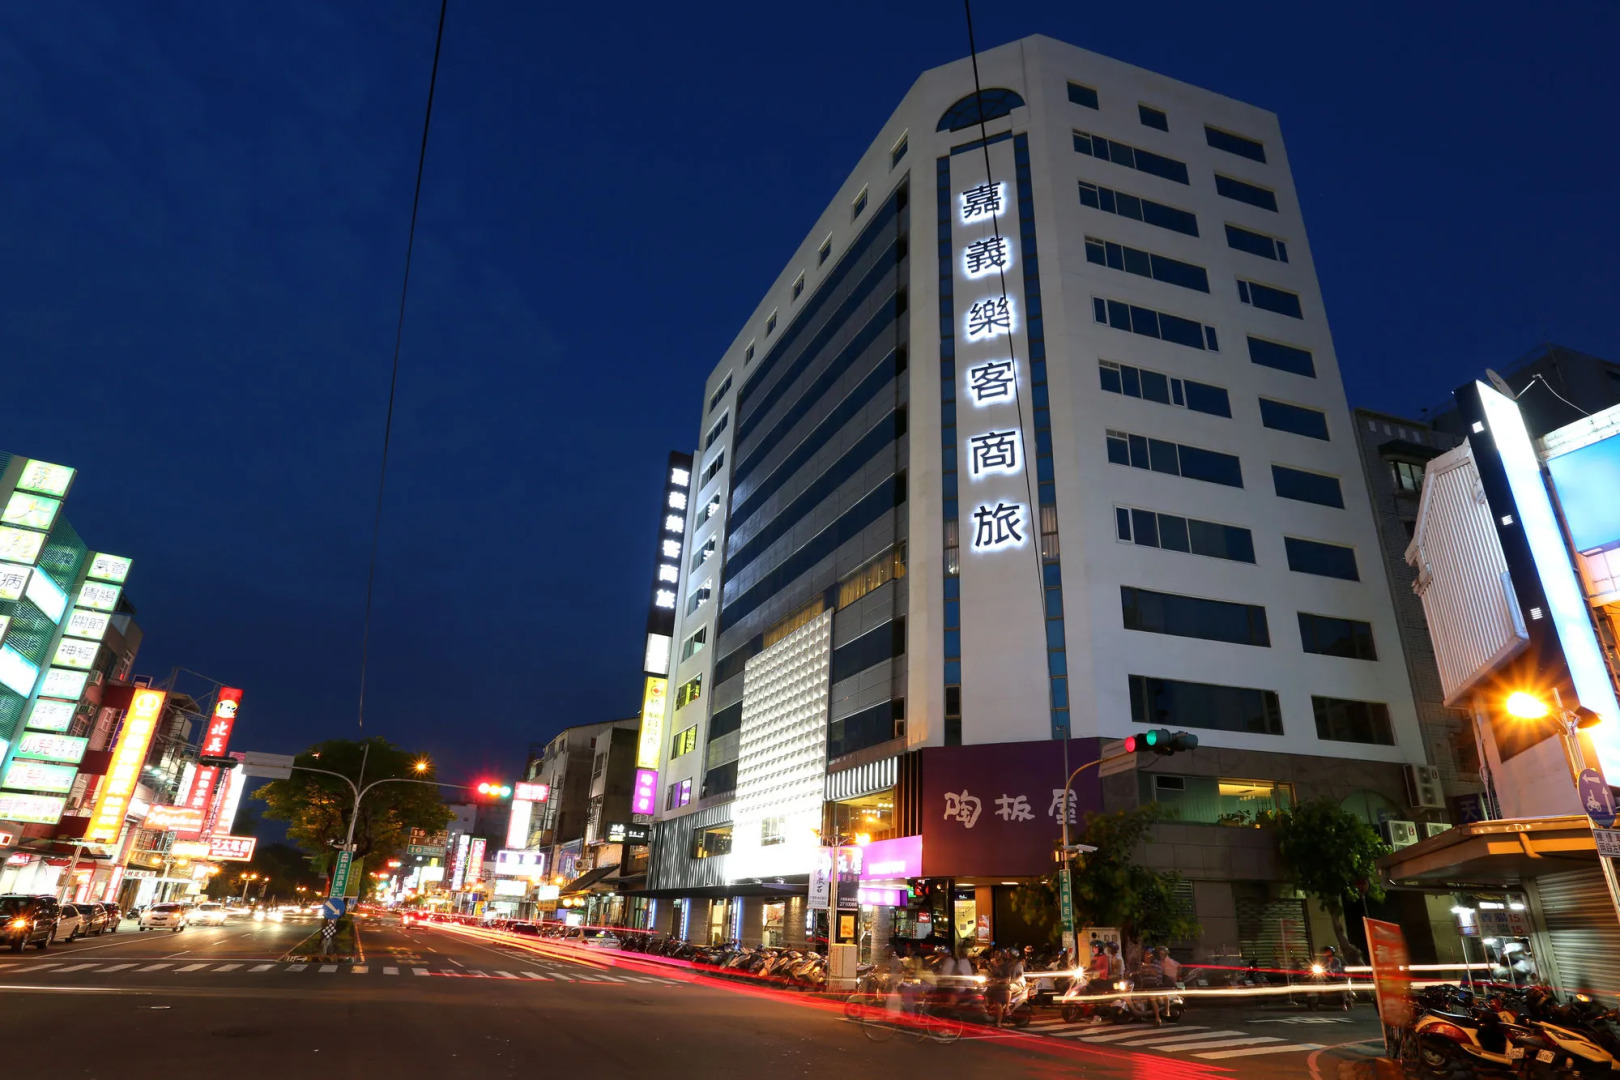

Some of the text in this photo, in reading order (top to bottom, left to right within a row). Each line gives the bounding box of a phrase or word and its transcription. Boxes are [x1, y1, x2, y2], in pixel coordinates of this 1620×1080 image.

[962, 181, 1022, 547] 嘉義樂客商旅
[71, 614, 104, 629] 關節
[60, 644, 94, 660] 神經
[943, 789, 1078, 828] 陶板屋
